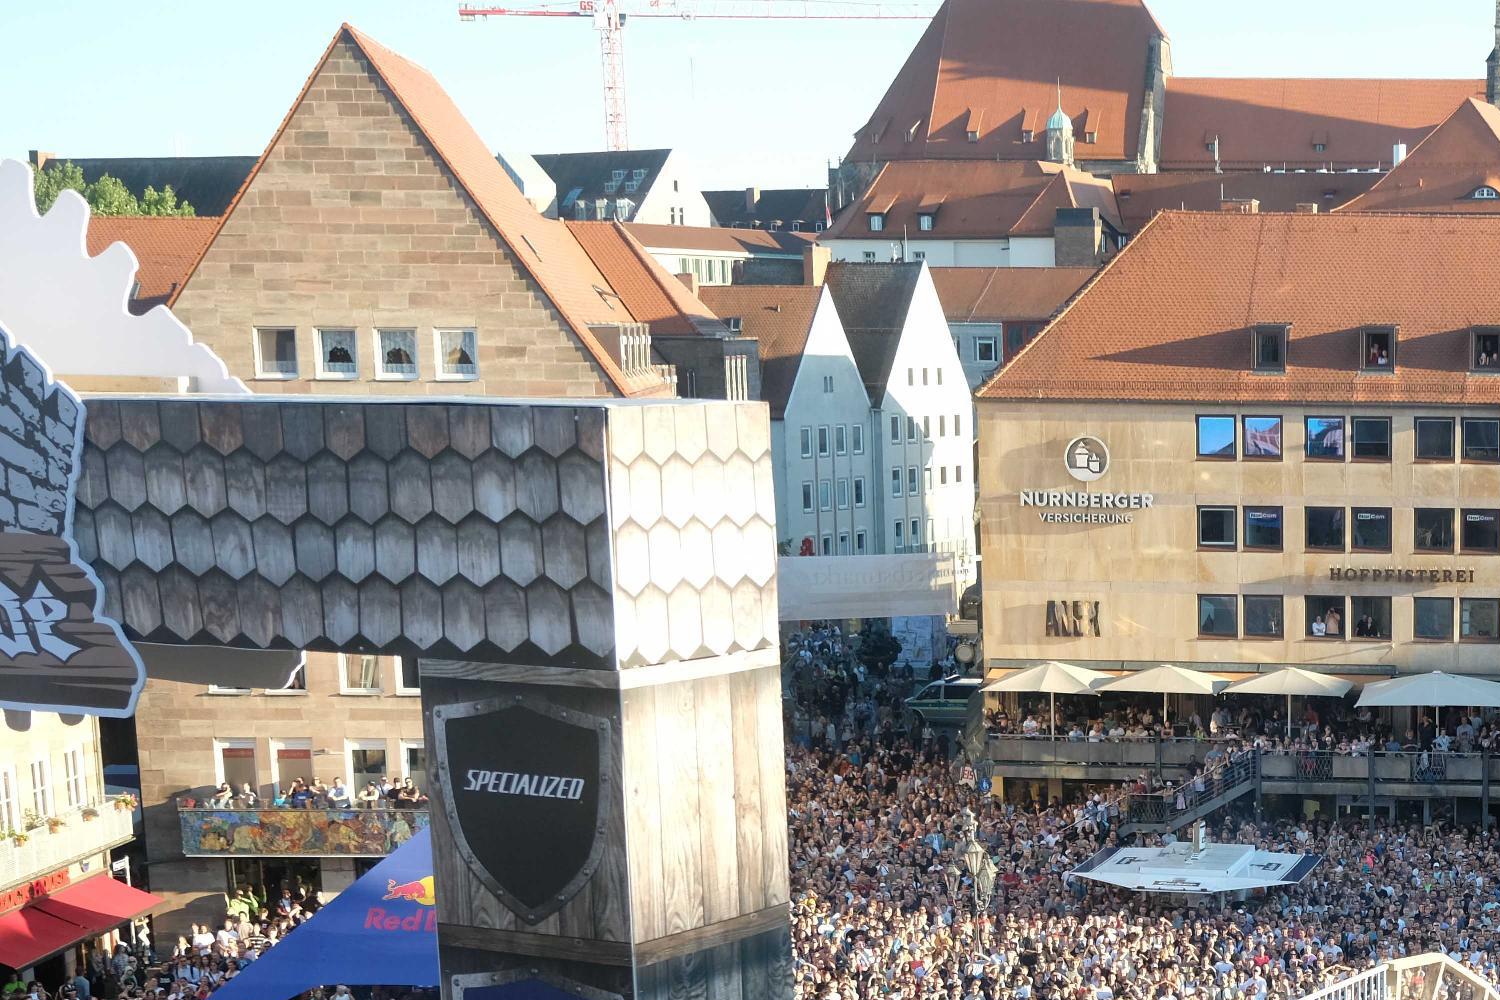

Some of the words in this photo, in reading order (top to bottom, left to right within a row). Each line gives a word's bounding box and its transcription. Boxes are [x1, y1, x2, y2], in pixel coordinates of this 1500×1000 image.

[1038, 512, 1134, 524] VERSICHERUNG
[1329, 567, 1475, 584] HOFPFISTEREI
[464, 769, 585, 800] SPECIALIZED
[364, 907, 425, 931] Red
